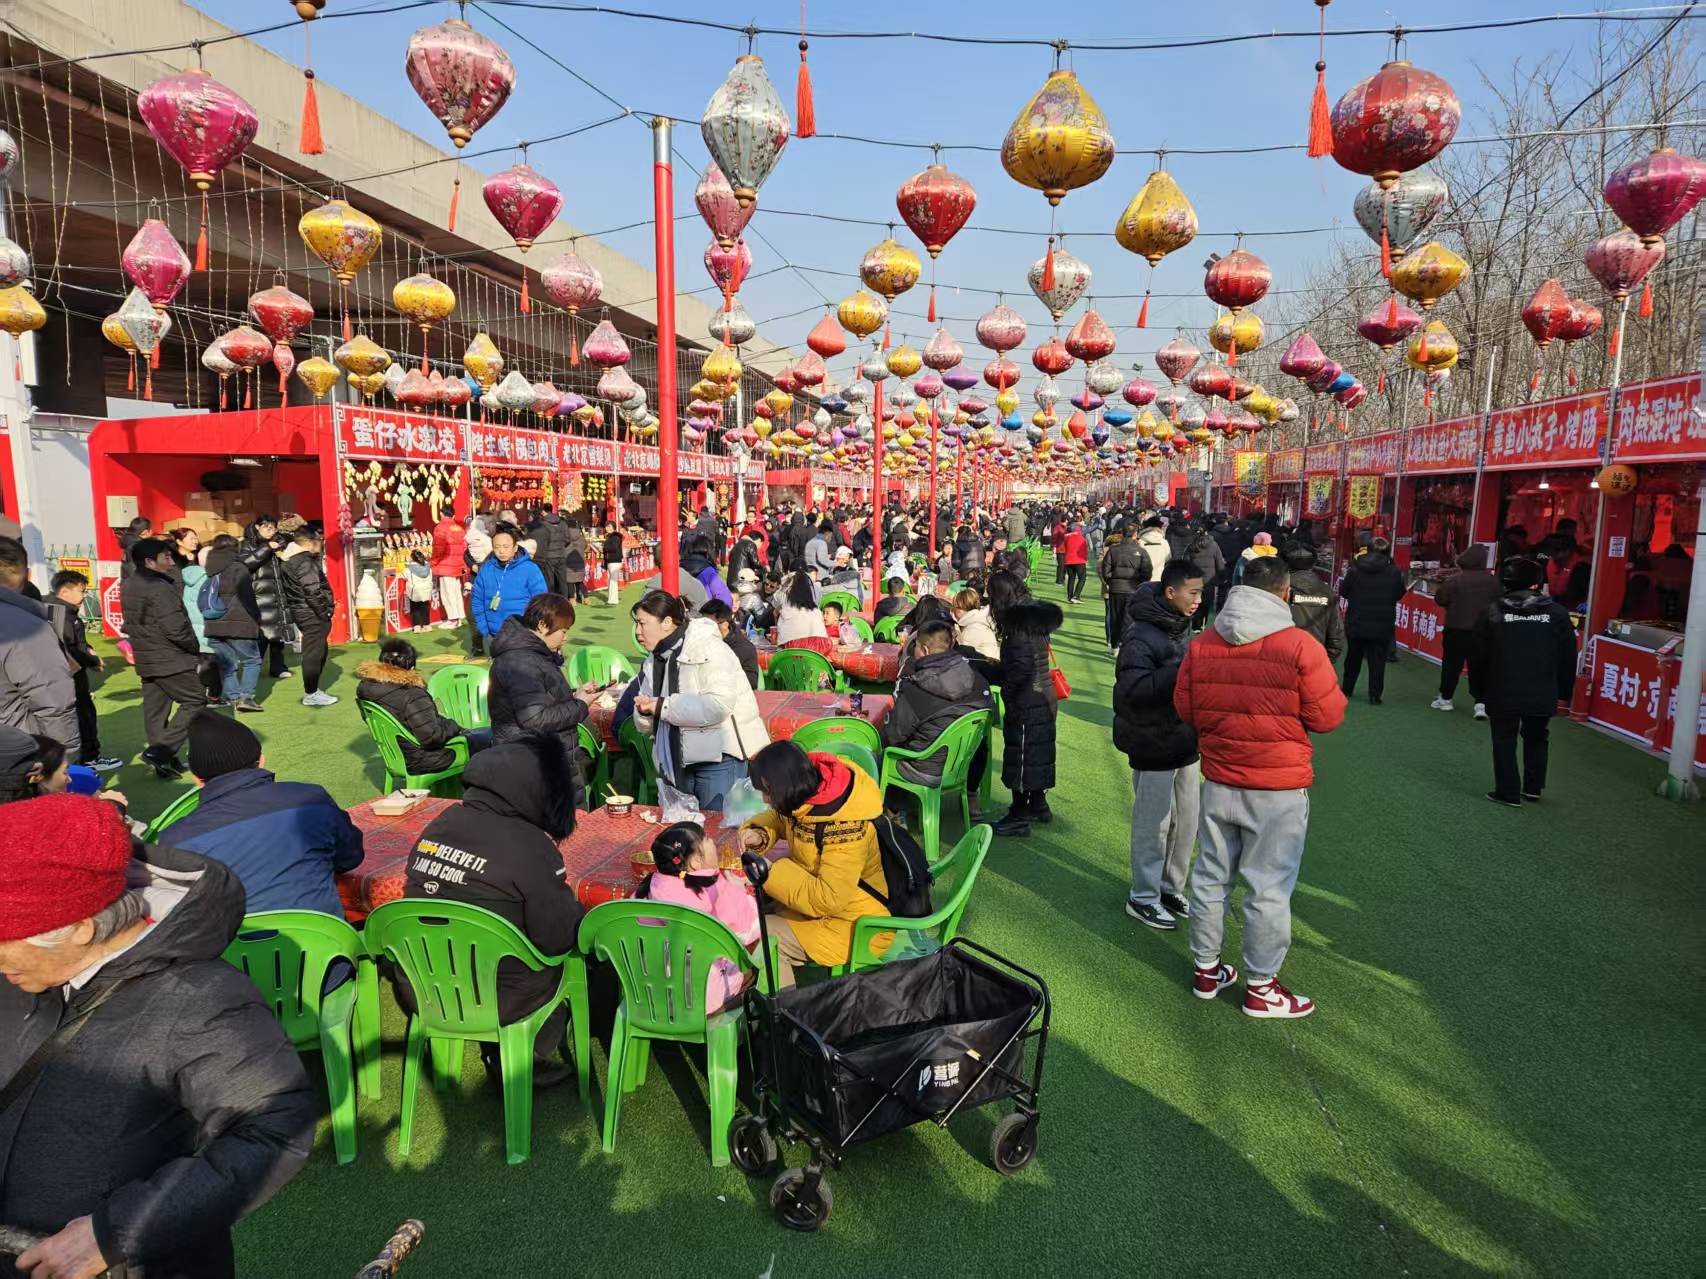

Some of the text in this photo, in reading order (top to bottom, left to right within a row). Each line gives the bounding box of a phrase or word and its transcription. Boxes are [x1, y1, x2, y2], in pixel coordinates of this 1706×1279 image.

[352, 417, 457, 455] 蛋仔冰激凌
[1492, 406, 1597, 459] 章鱼小丸子·烤肠
[427, 861, 443, 877] SO
